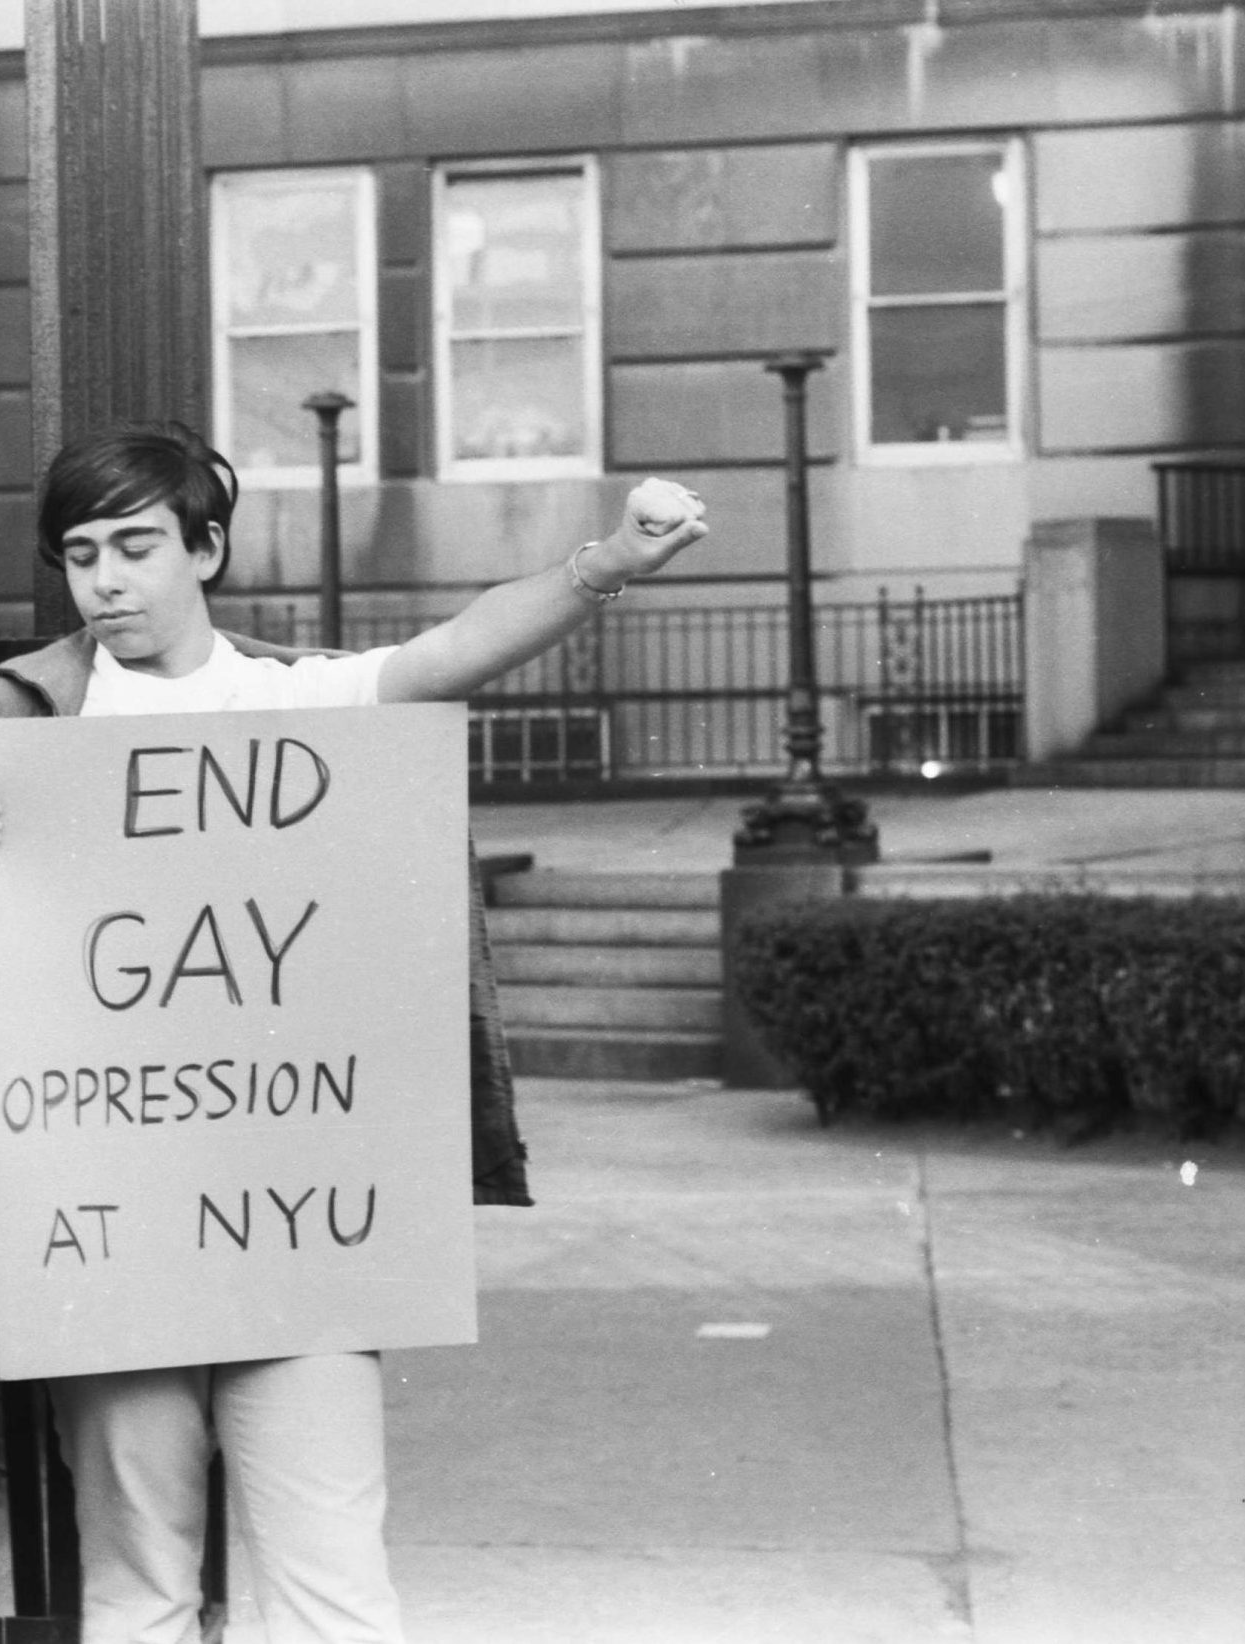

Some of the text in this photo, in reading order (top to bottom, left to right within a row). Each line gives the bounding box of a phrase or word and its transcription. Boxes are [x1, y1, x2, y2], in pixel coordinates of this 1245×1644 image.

[123, 738, 331, 839] END
[82, 898, 320, 1011] GAY
[1, 1054, 357, 1133] OPPRESSION
[43, 1183, 376, 1268] AT NYU
